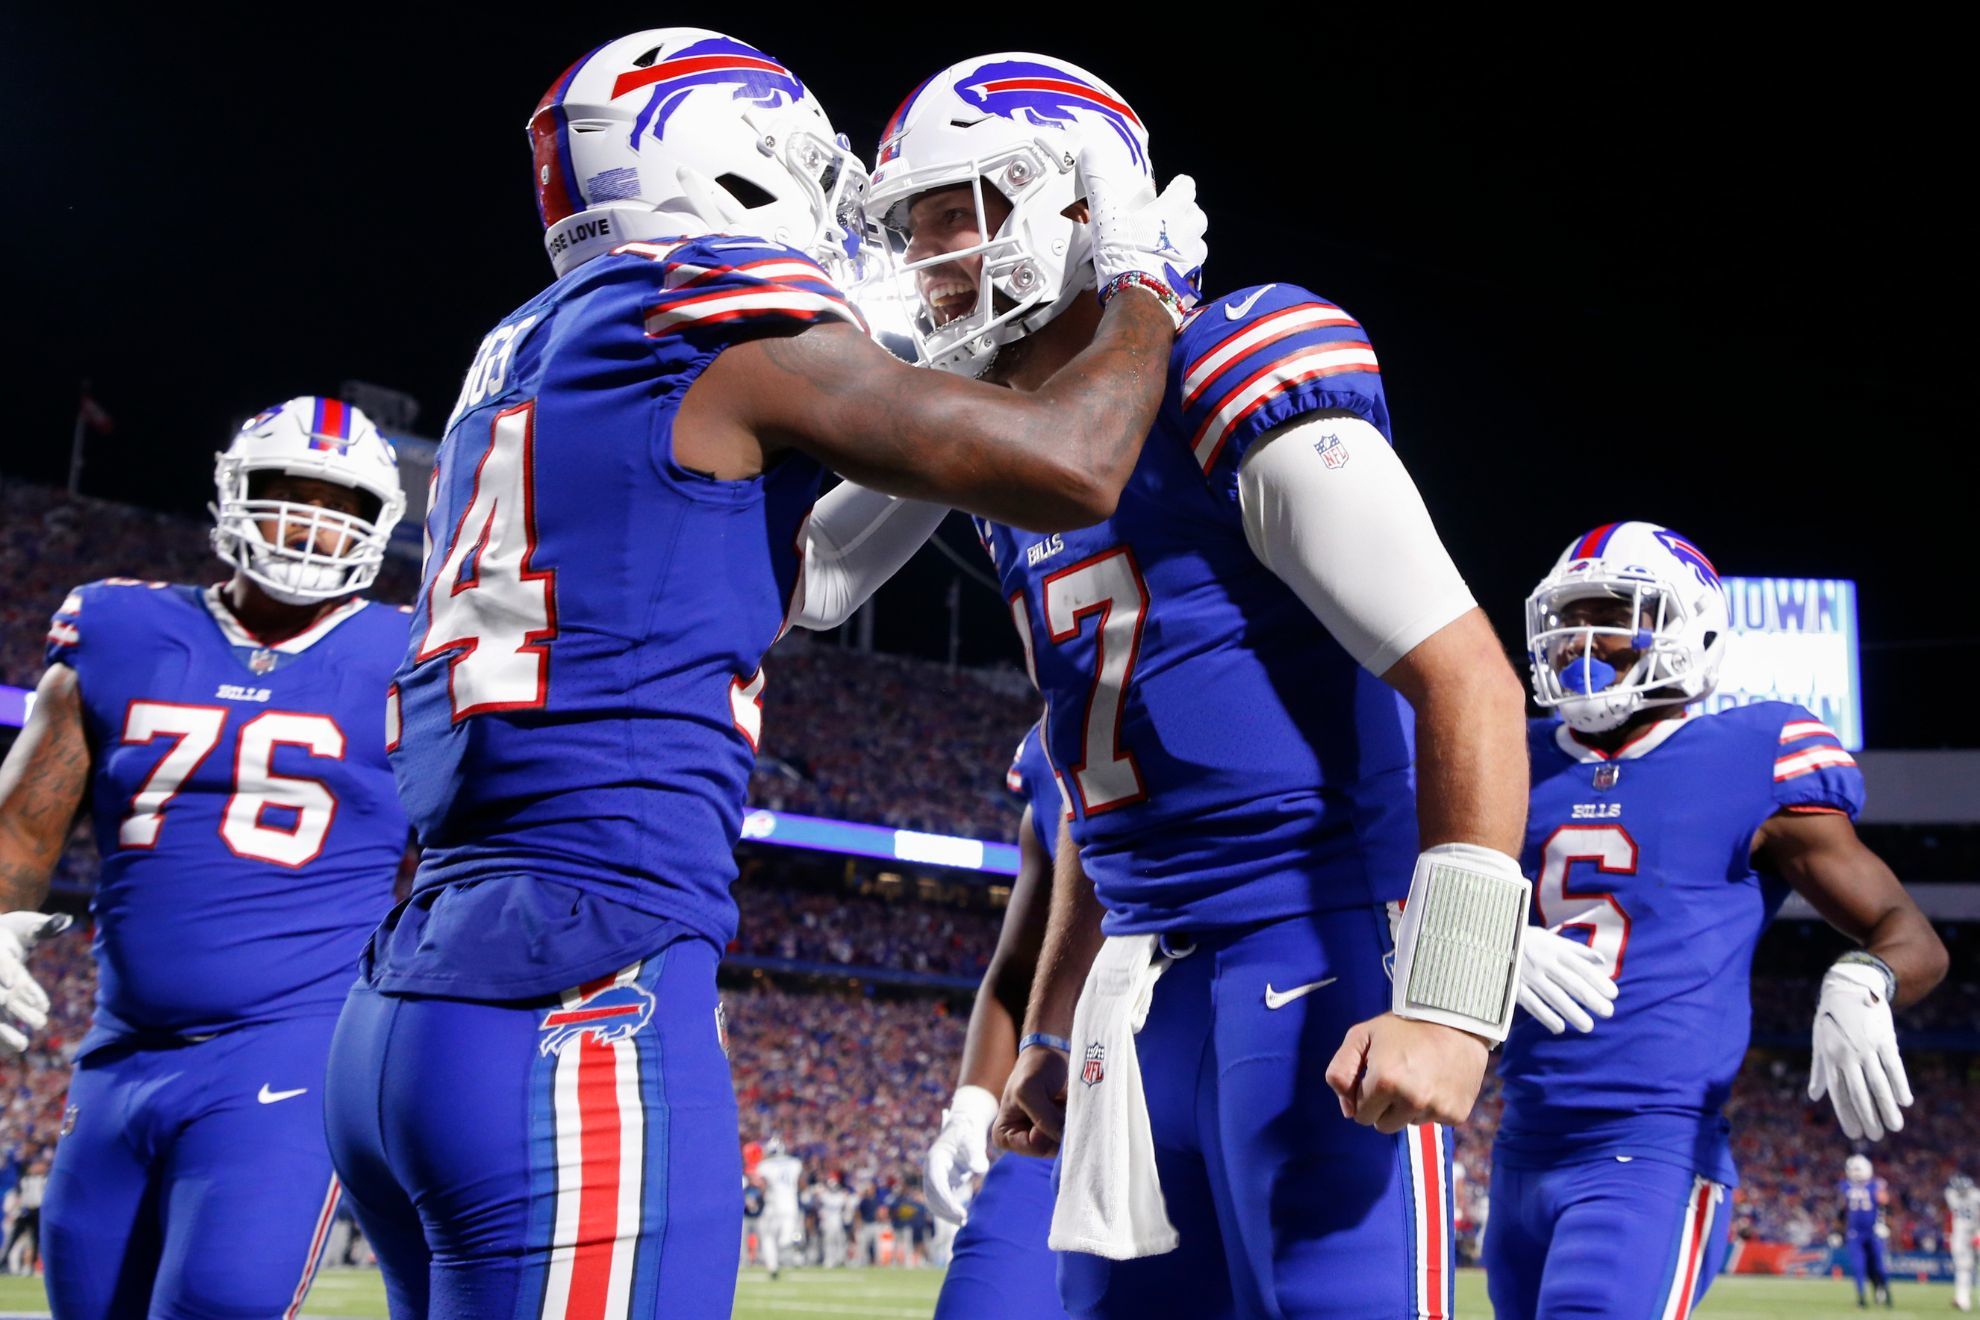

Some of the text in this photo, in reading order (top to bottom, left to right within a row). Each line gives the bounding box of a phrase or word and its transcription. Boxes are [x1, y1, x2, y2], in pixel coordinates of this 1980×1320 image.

[567, 218, 610, 245] LOVE
[1027, 533, 1065, 567] BILLS
[385, 396, 558, 752] 4
[215, 684, 272, 703] BILLS
[118, 699, 347, 869] 76
[1571, 803, 1621, 819] BILLS
[1537, 823, 1639, 981] 6
